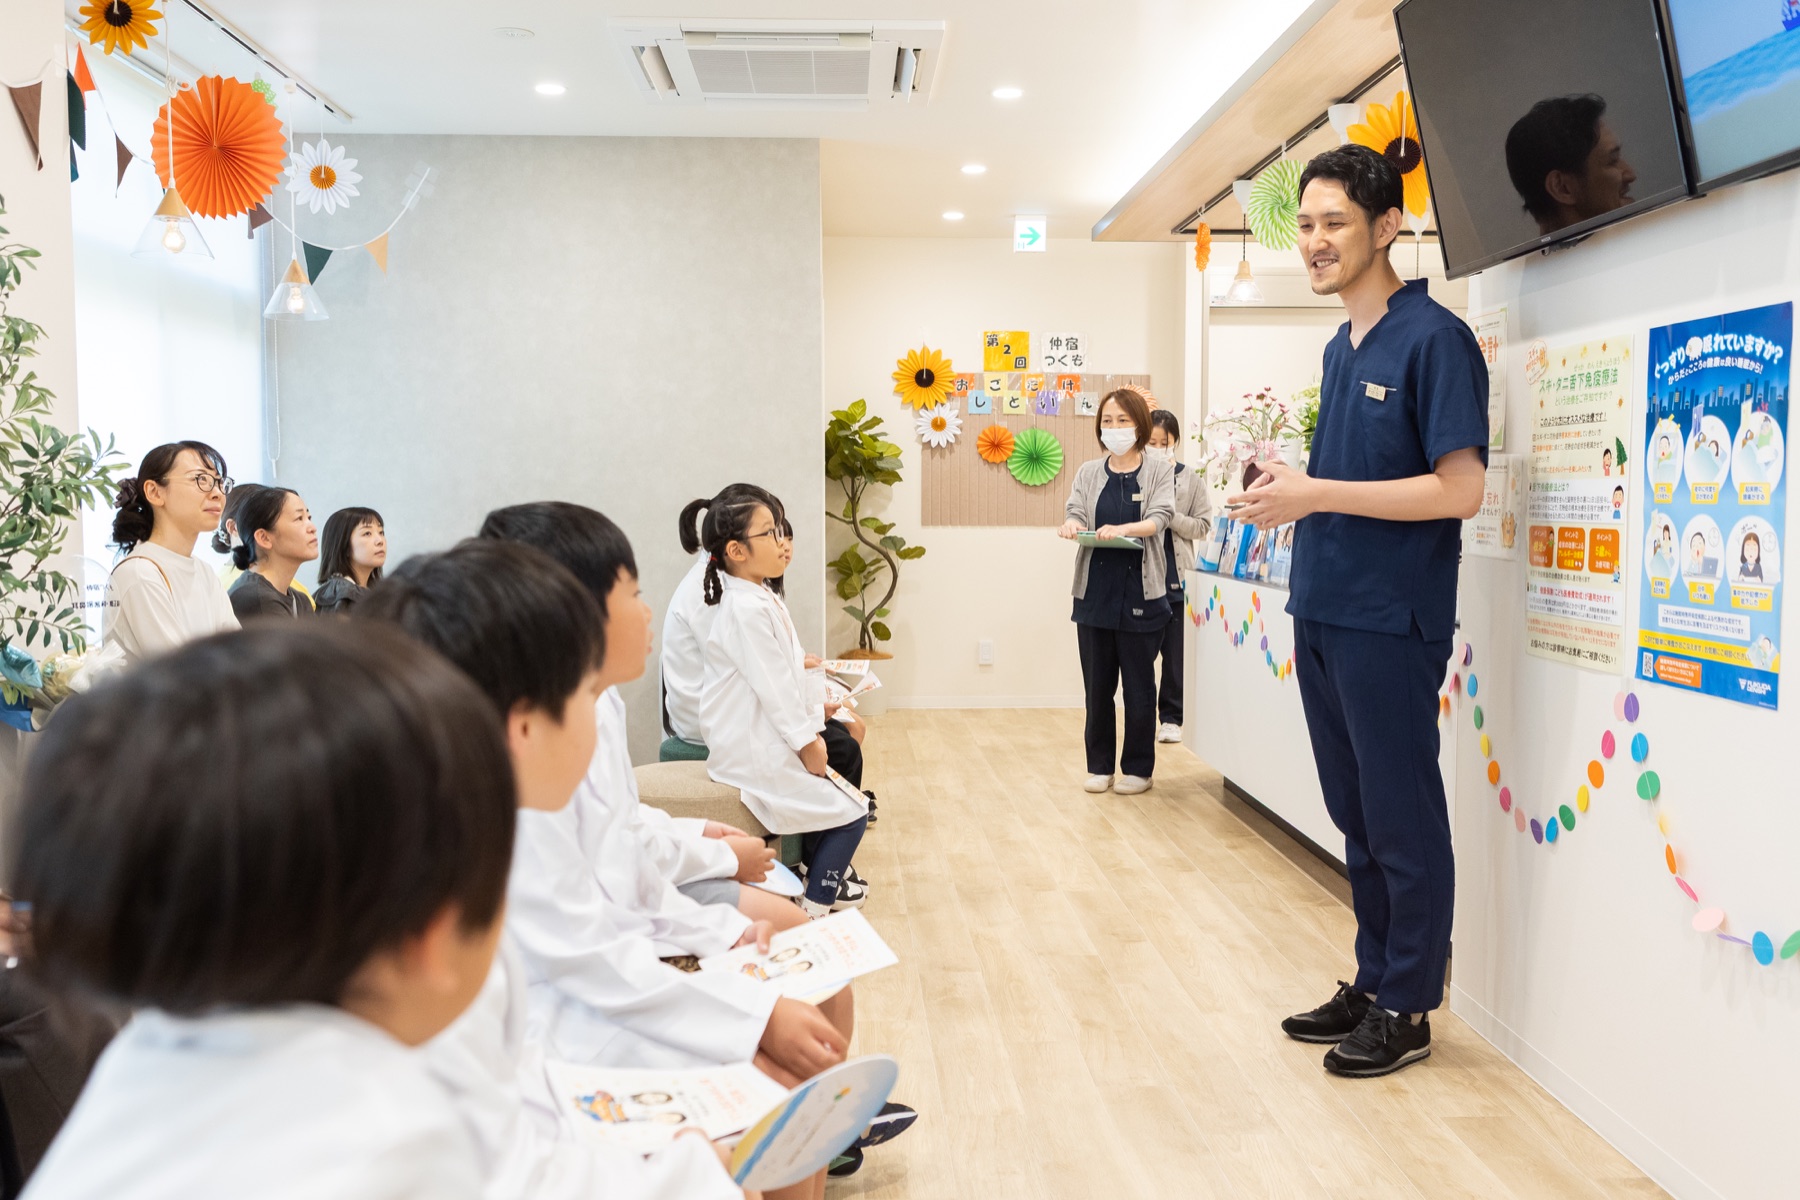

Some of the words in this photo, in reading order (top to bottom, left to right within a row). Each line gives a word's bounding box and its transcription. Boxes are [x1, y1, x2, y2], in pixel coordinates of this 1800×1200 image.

[1050, 337, 1079, 351] 仲宿
[987, 334, 1027, 369] 第2回
[1045, 355, 1083, 367] つくも
